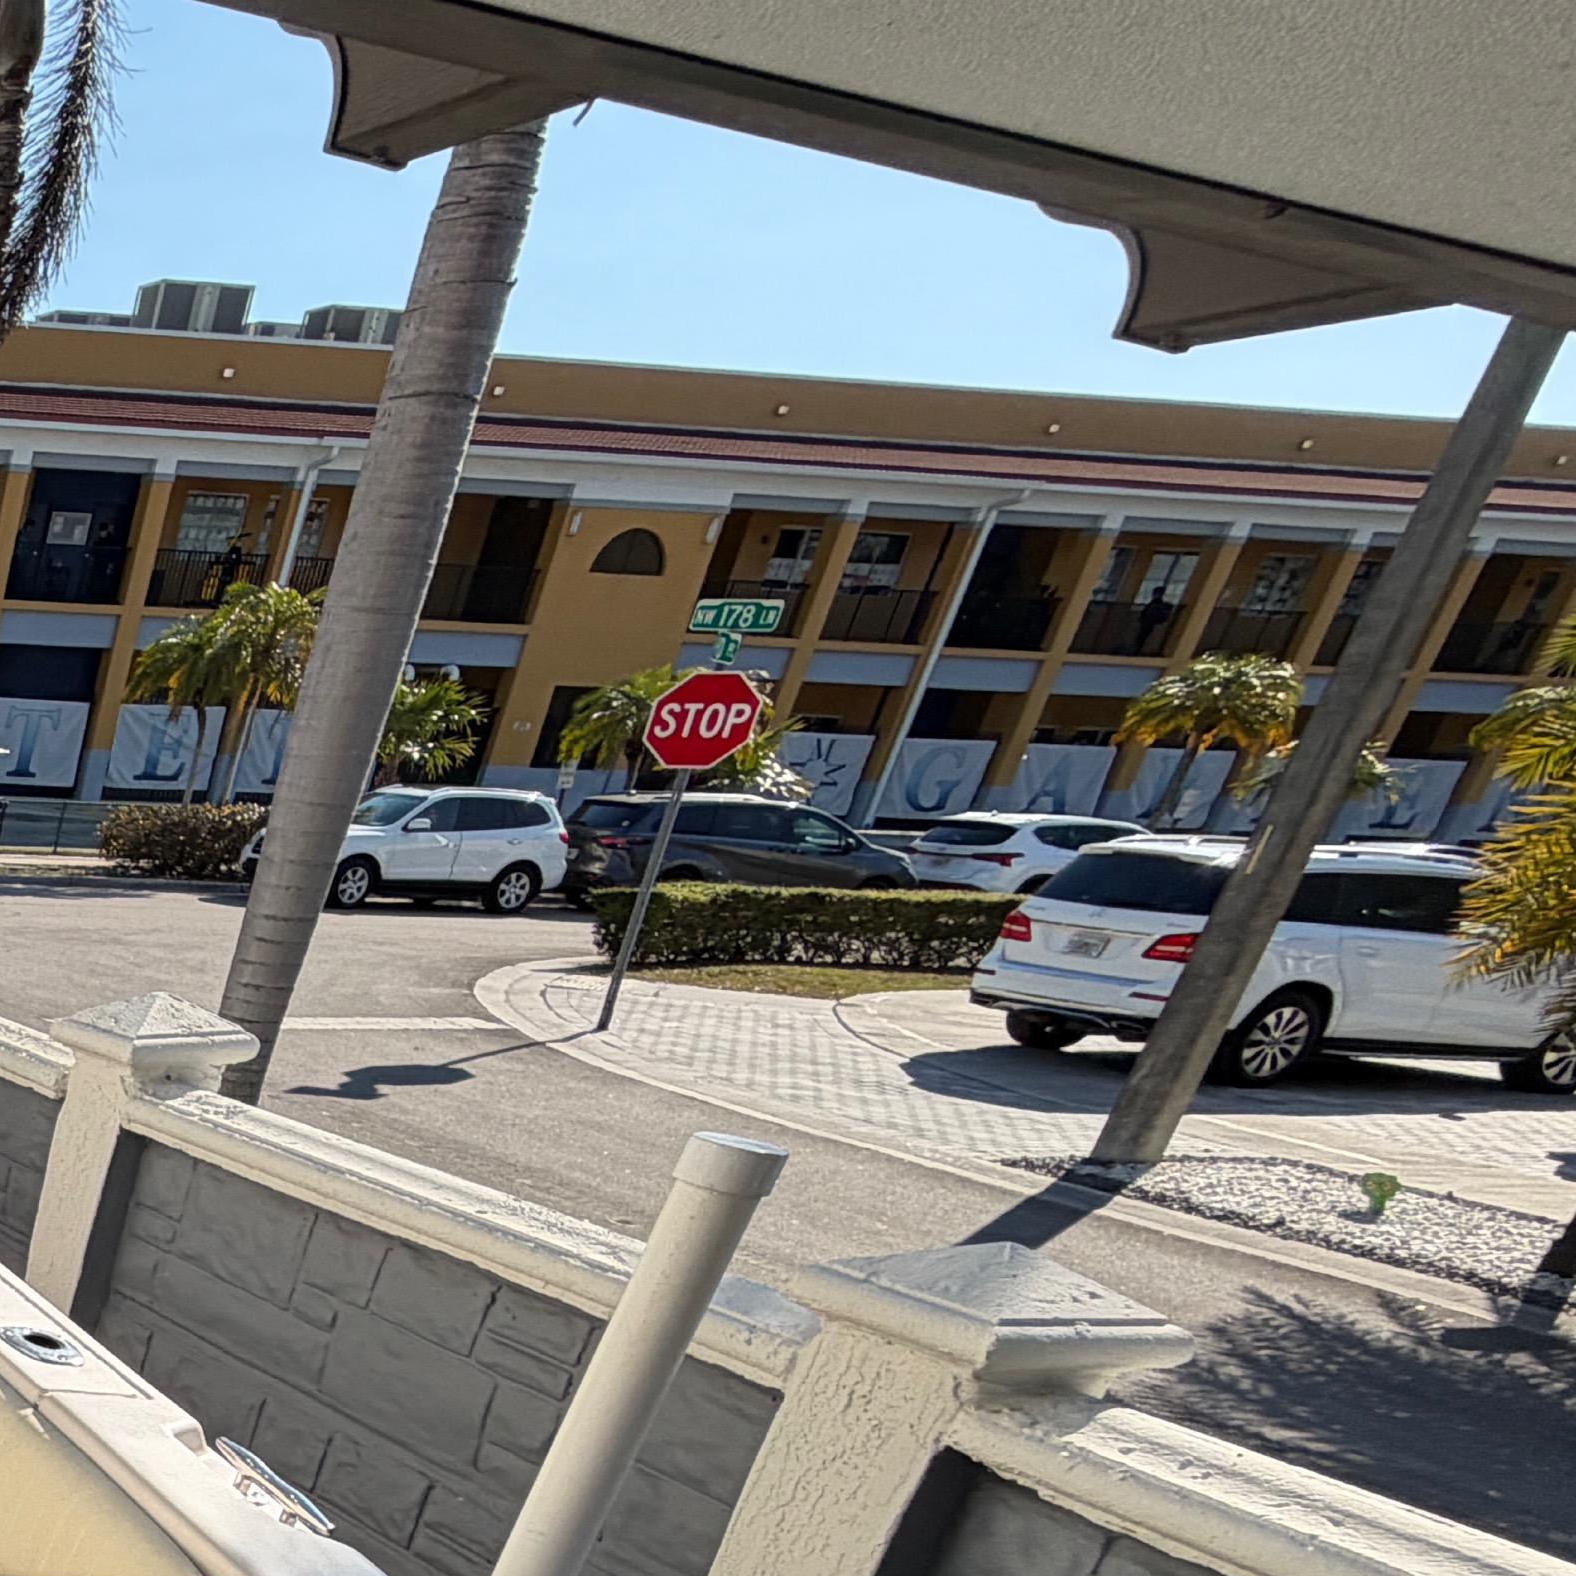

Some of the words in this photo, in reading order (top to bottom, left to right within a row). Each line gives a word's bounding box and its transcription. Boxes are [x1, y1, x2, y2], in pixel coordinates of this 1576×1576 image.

[694, 609, 717, 625] NW
[719, 605, 756, 628] 178
[759, 609, 779, 625] LN
[654, 702, 752, 739] STOP
